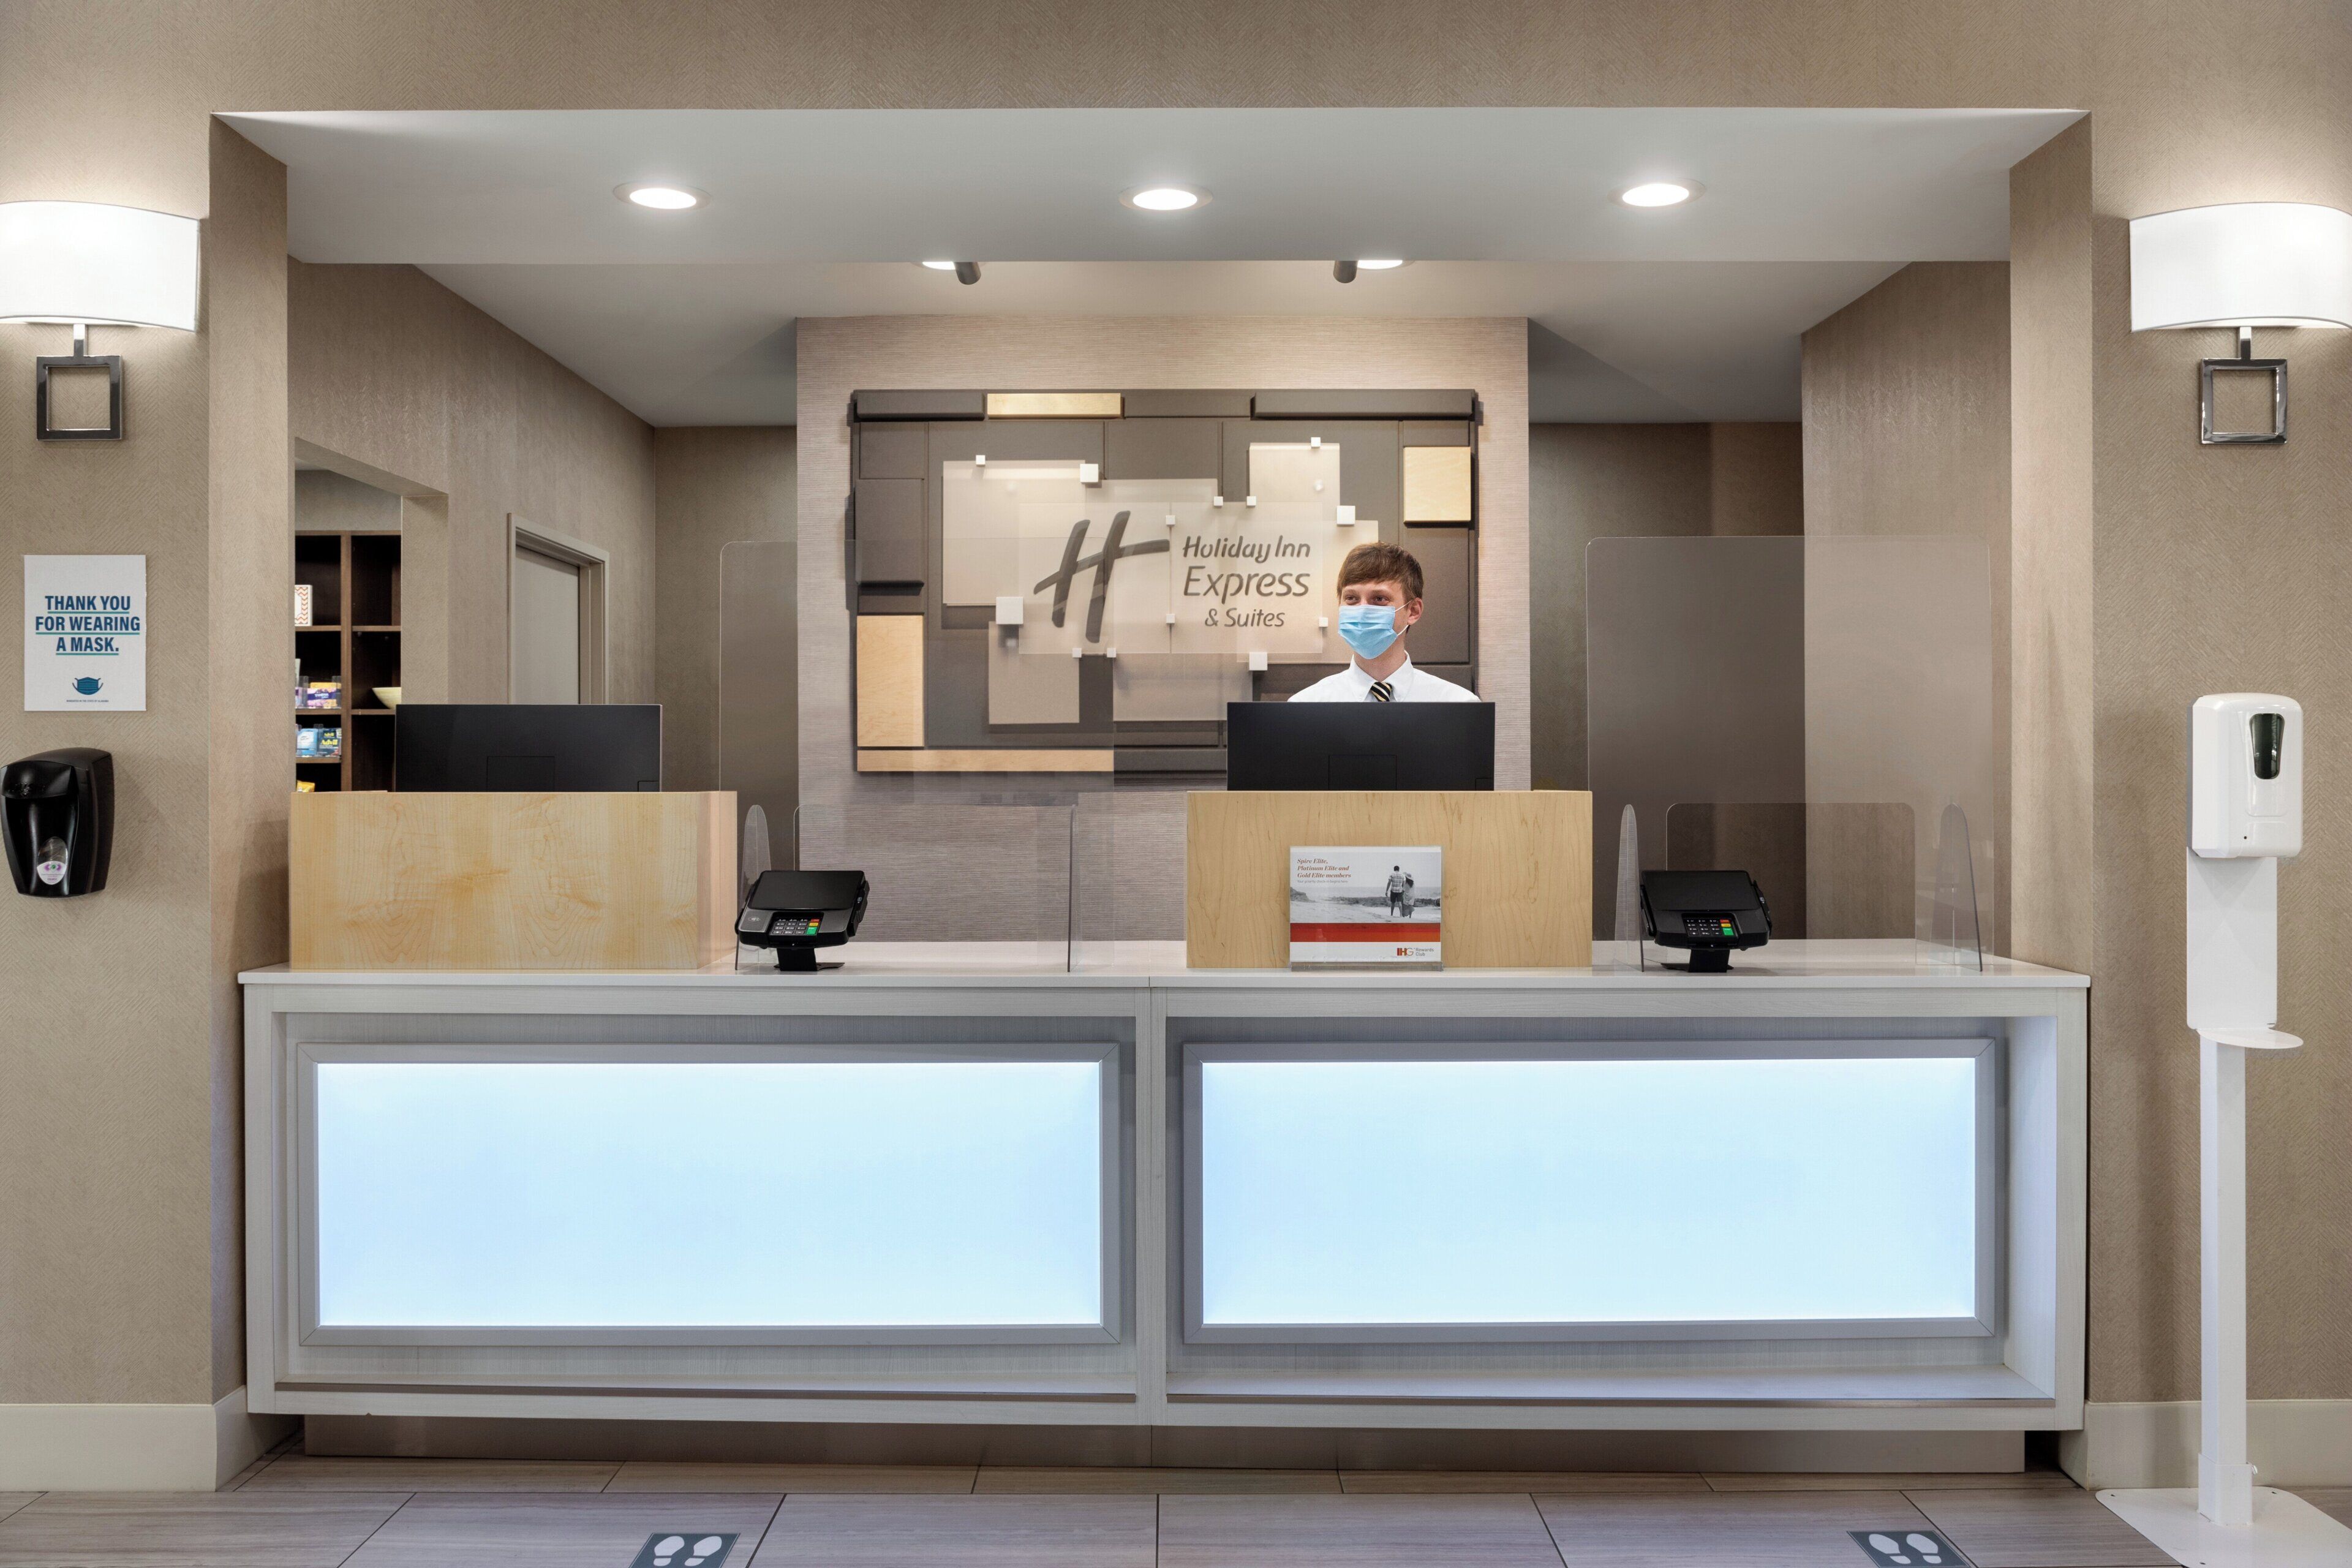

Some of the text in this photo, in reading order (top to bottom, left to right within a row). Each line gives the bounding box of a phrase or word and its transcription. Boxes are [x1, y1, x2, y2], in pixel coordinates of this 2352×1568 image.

[1183, 535, 1311, 563] Holiday Inn
[1183, 565, 1311, 605] Express
[45, 595, 131, 611] THANK YOU
[36, 616, 140, 631] FOR WEARING
[1205, 607, 1286, 627] & Suites
[56, 637, 119, 652] A MASK.
[1396, 948, 1414, 956] IHG
